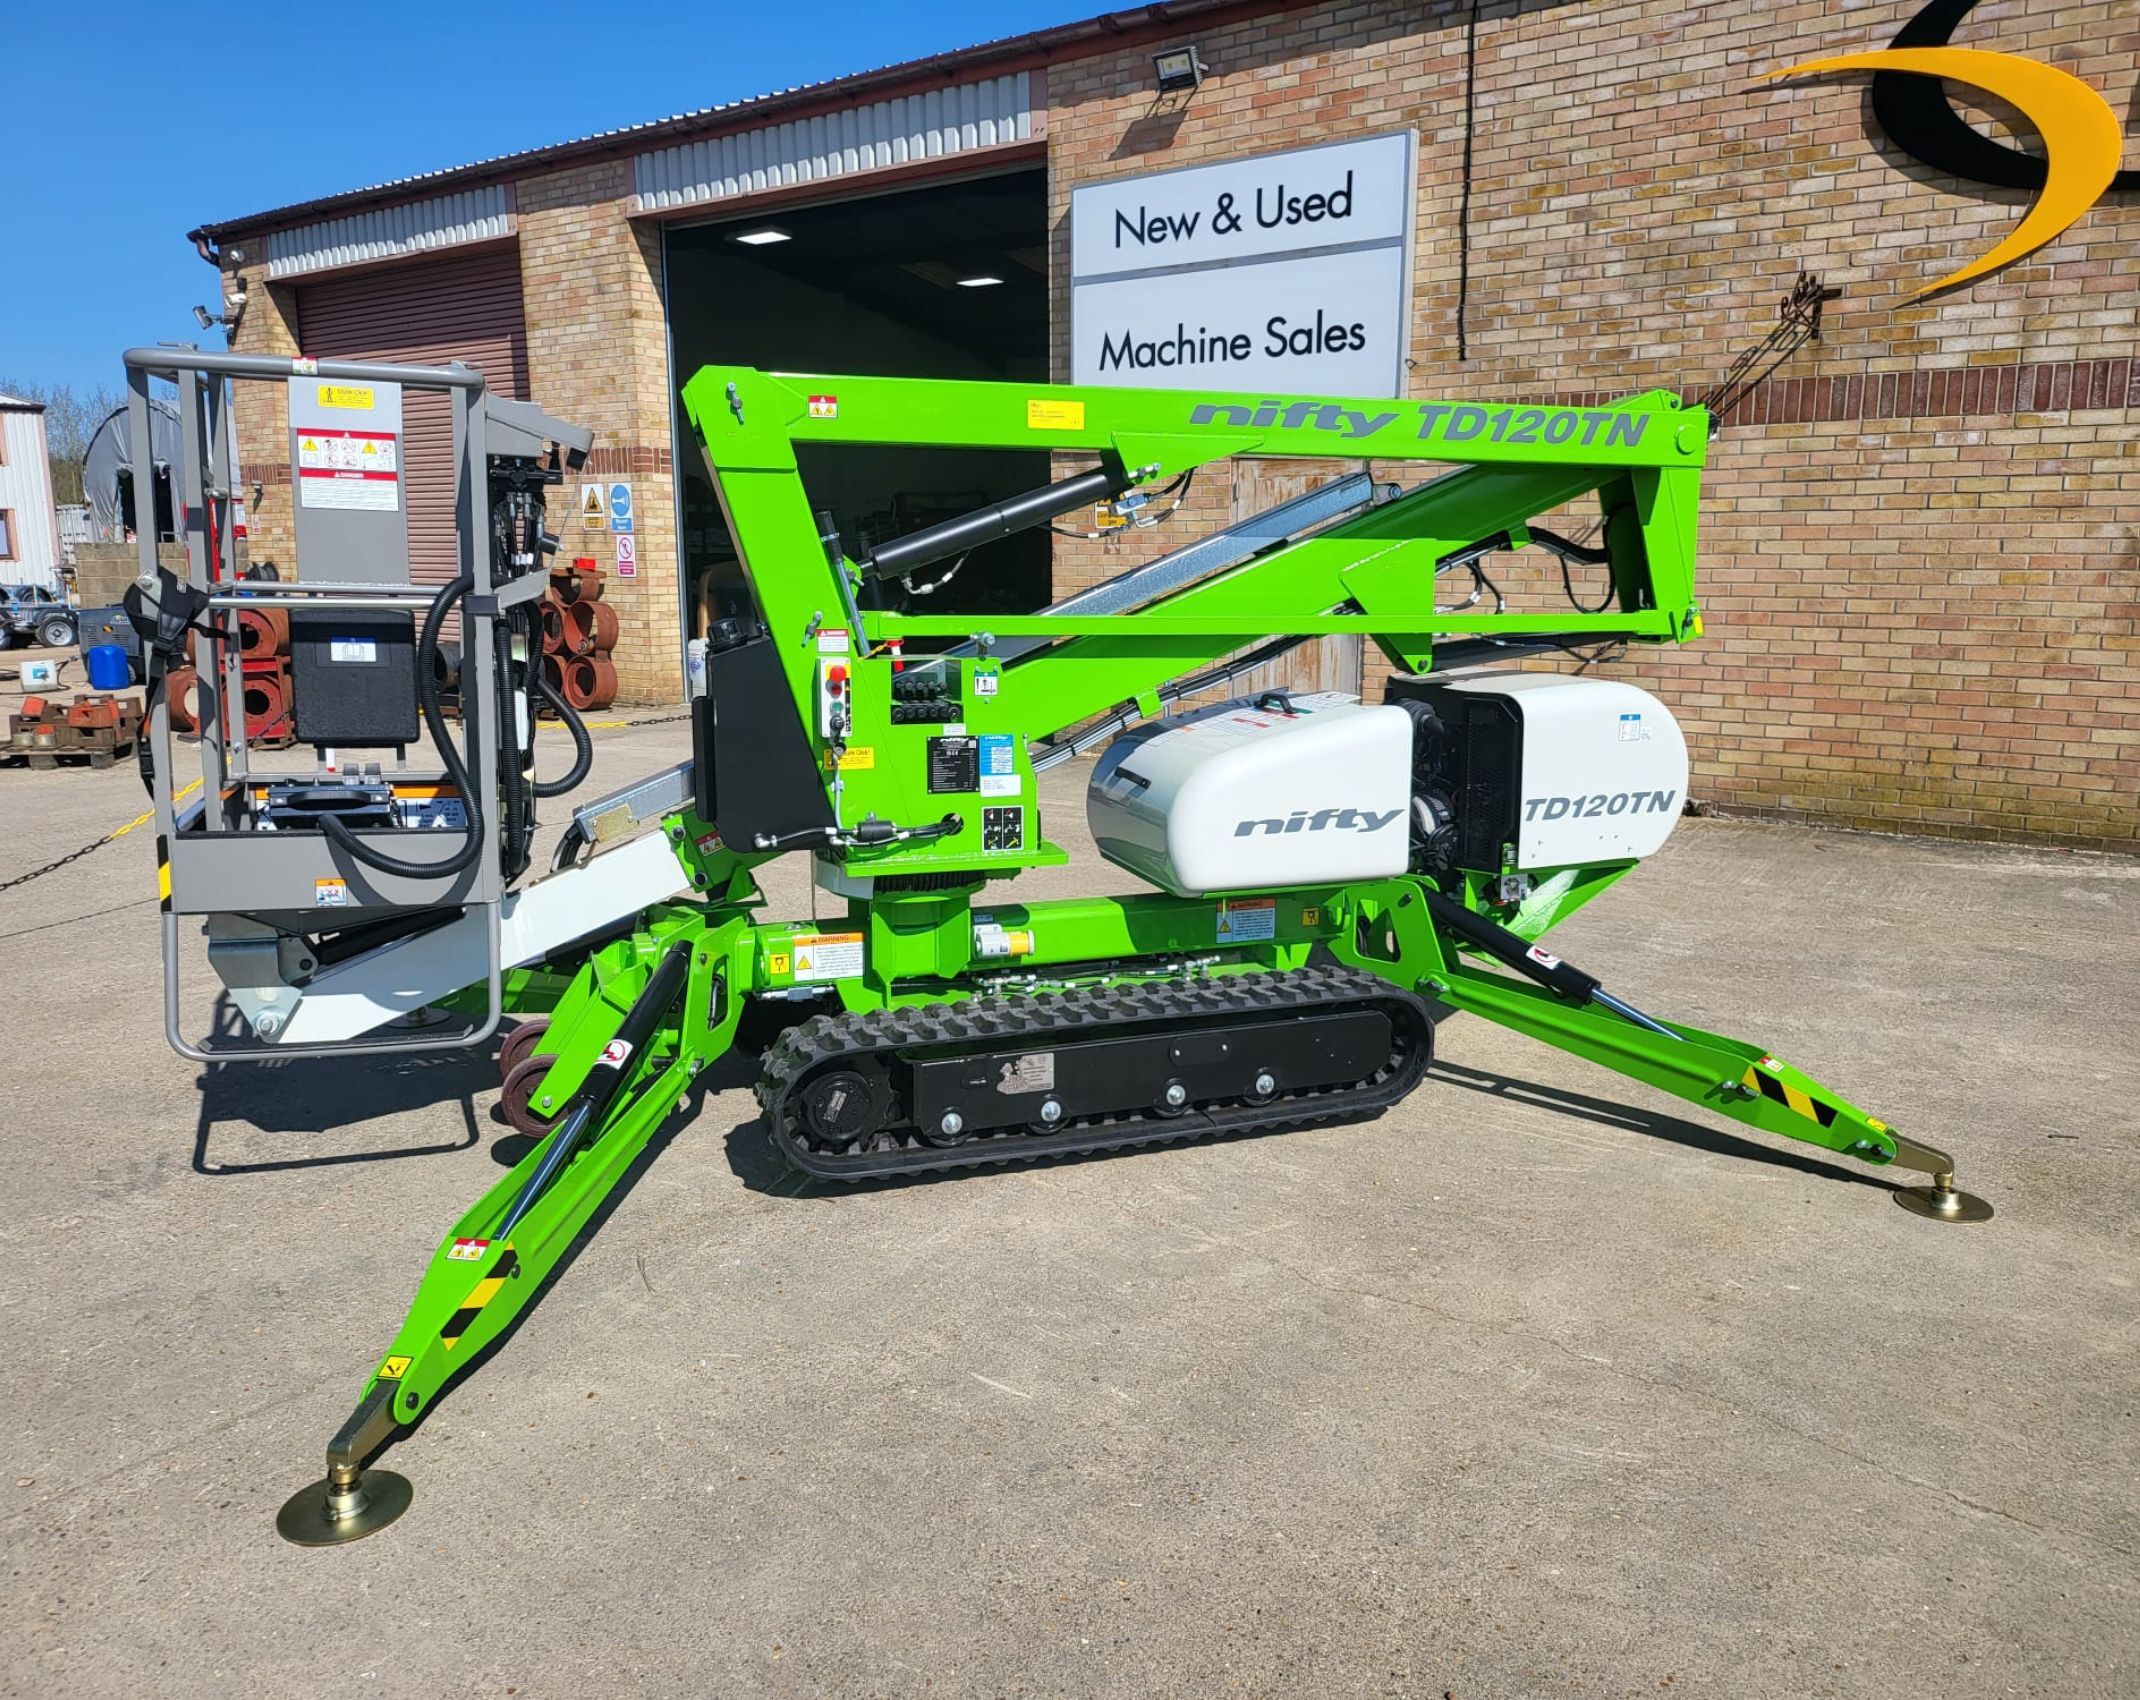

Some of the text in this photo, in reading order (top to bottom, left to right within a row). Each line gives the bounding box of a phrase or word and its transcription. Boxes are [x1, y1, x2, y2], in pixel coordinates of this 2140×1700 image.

[1115, 169, 1353, 249] New & Used
[1099, 309, 1366, 371] Machine Sales
[1190, 400, 1650, 448] nifty TD120TN
[1234, 808, 1406, 837] nifty
[1523, 788, 1676, 823] TD120TN
